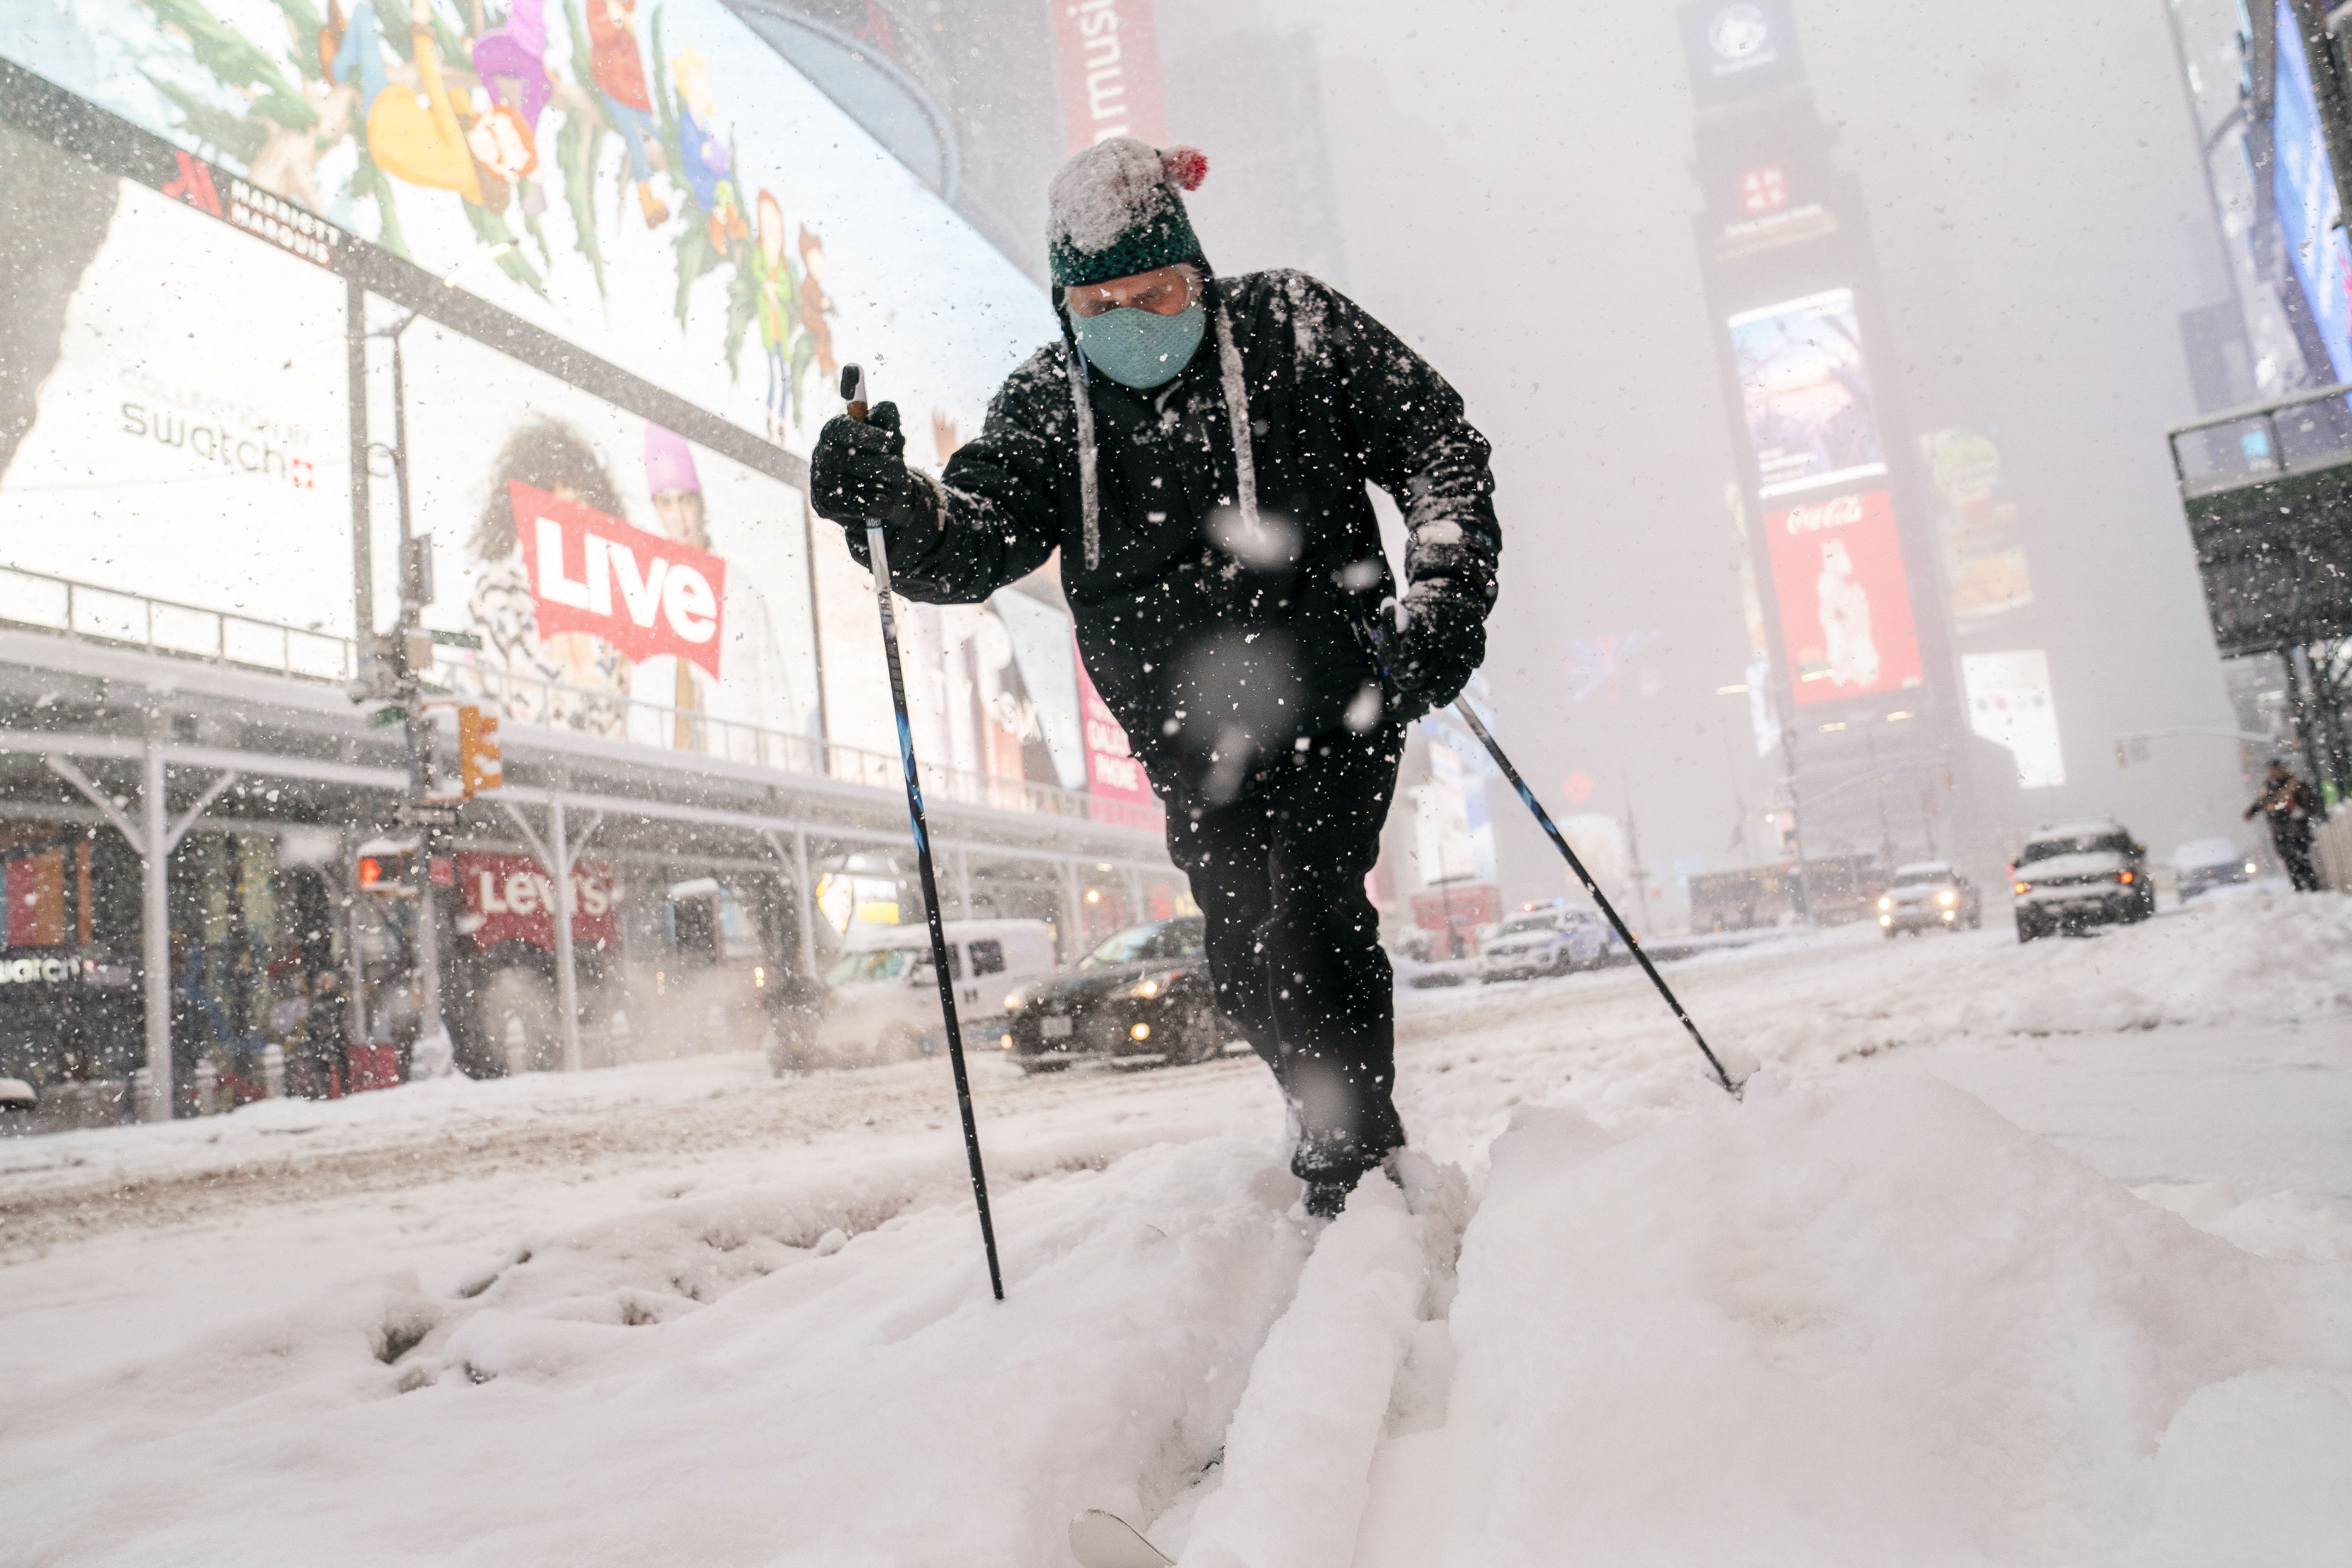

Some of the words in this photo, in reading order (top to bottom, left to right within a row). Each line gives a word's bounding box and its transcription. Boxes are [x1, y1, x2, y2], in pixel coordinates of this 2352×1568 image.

[231, 179, 341, 246] MARRIOTT
[231, 201, 330, 264] MARQUIS
[121, 401, 287, 480] swatch
